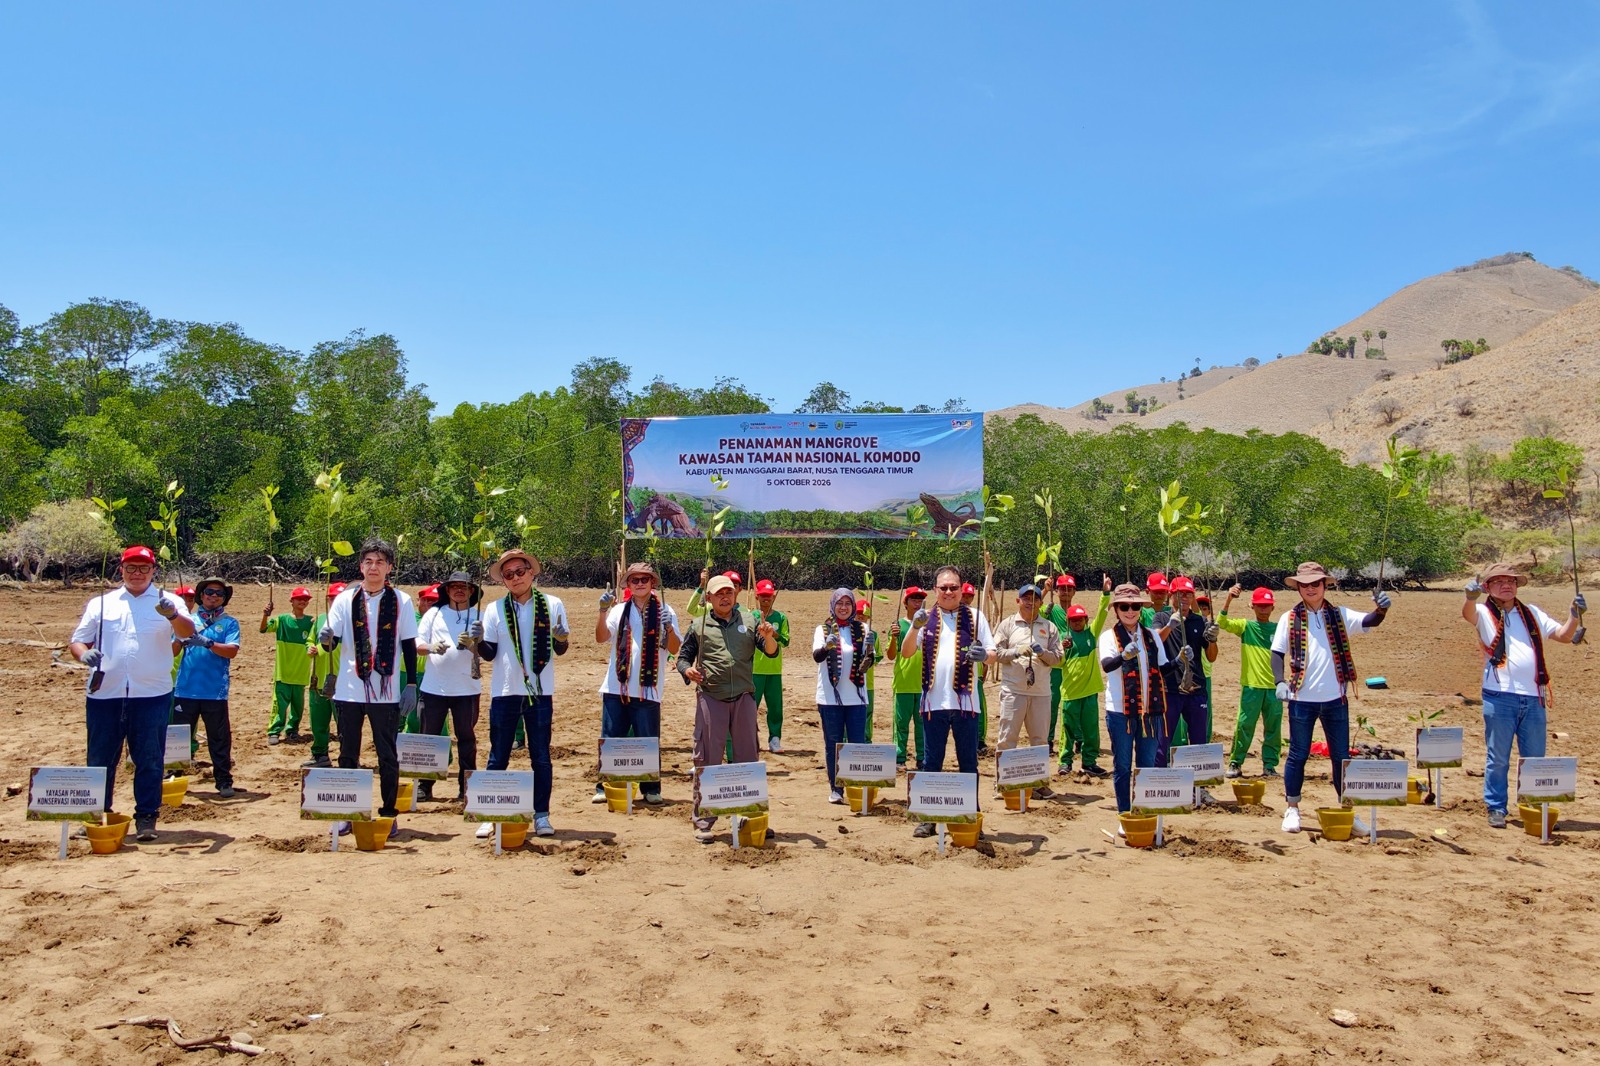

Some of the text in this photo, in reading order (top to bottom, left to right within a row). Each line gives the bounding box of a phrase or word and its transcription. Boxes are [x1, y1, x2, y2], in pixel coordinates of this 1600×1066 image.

[719, 437, 878, 450] PENANAMAN MANGROVE
[679, 451, 921, 465] KAWASAN TAMAN NASIONAL KOMODO
[686, 468, 733, 476] KABUPATEN
[735, 467, 785, 475] MANGGARAI
[787, 467, 814, 475] BARAT,
[614, 758, 644, 766] DENDY SEAN
[849, 763, 883, 772] RINA LISTIANI
[1347, 781, 1403, 790] MOTOFUMI MARUTANI
[1535, 778, 1553, 787] SUWITO
[46, 789, 91, 797] YAYASAN PEMUDA
[317, 792, 357, 802] NAOKI KAJINO
[722, 790, 743, 800] NASIONAL
[1145, 789, 1180, 798] RITA PRAJITNO
[37, 797, 97, 806] KONSERVASI INDONESIA
[477, 795, 520, 804] YUICHI SHIMIZU
[920, 796, 964, 806] THOMAS WIJAYA
